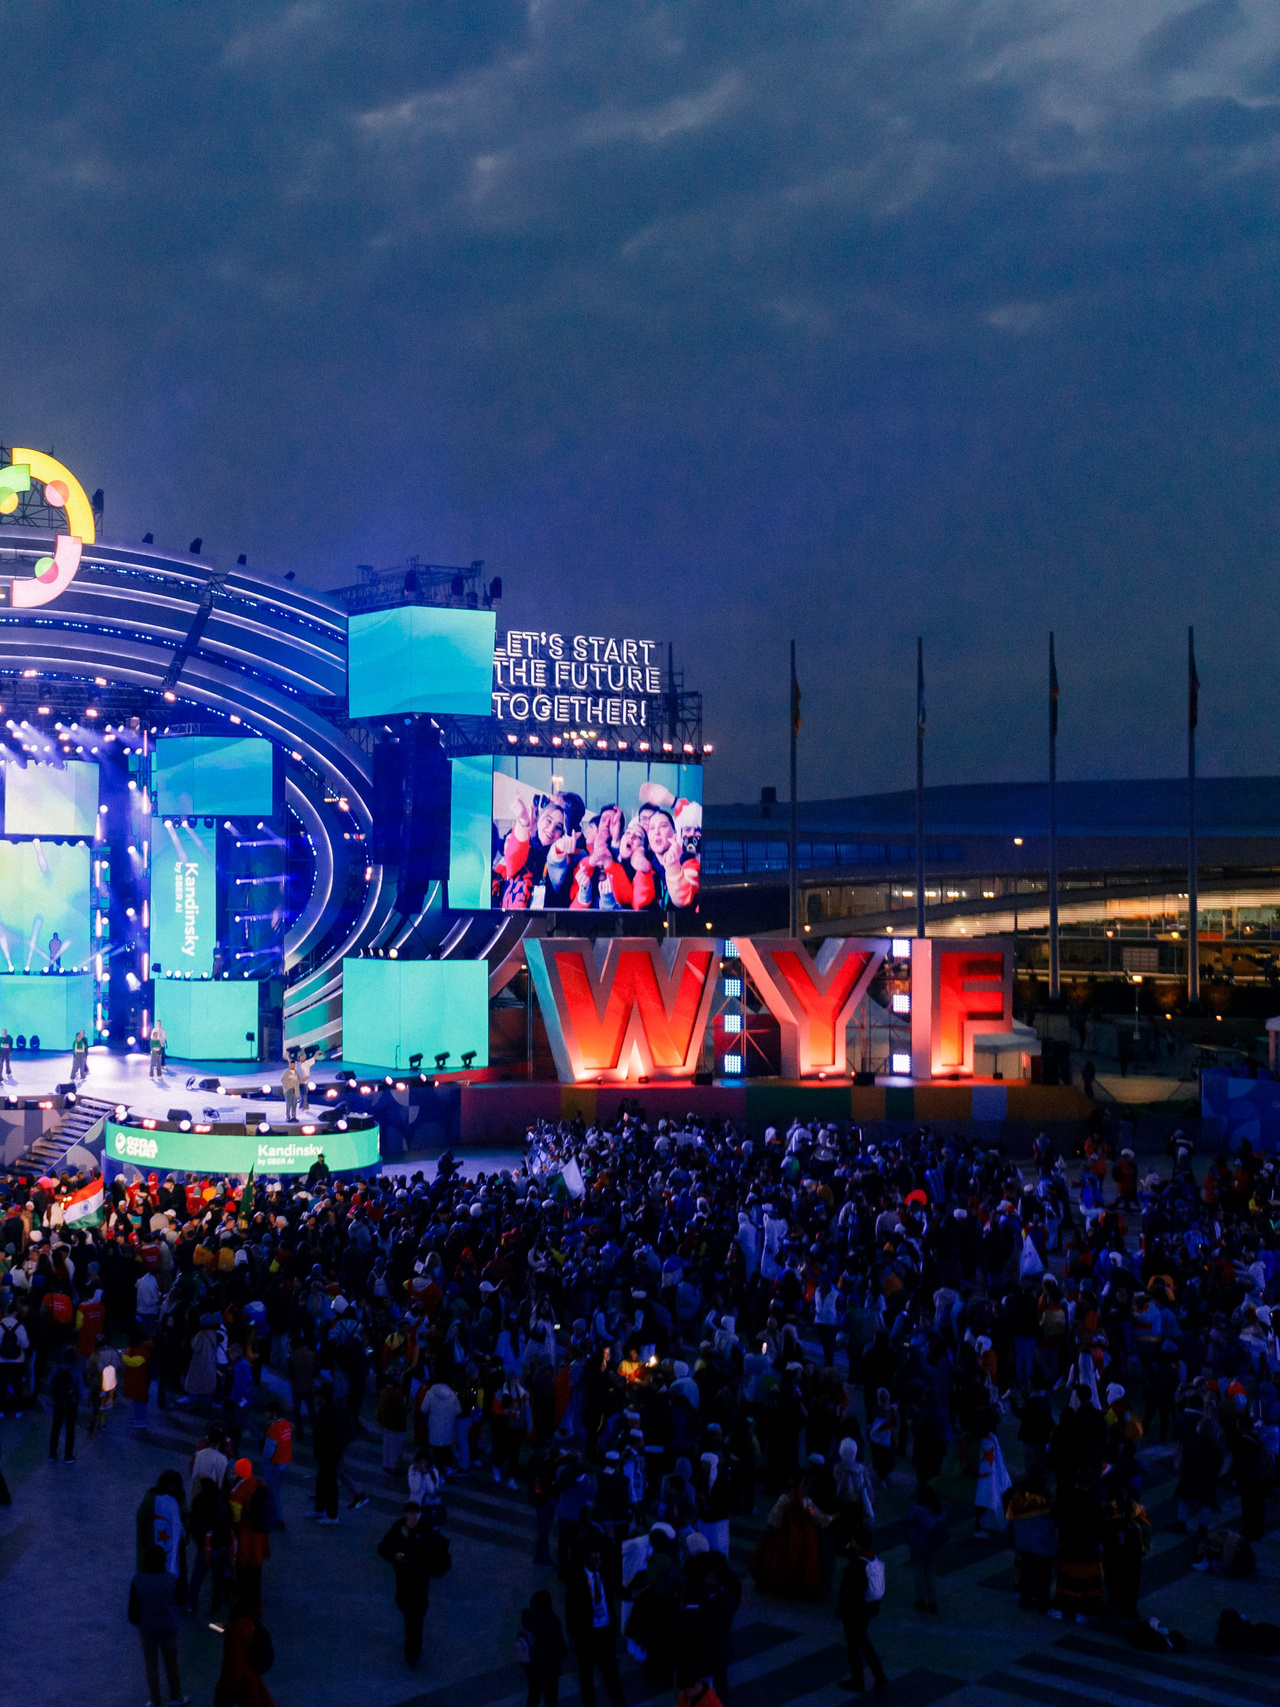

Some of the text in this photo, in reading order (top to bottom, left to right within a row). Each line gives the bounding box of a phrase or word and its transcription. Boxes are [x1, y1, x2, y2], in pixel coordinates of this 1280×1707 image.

[573, 635, 655, 665] START
[493, 657, 661, 693] THE FUTURE
[492, 692, 647, 726] TOGETHER!
[174, 862, 183, 873] by
[182, 863, 199, 957] Kandinsky
[526, 938, 1013, 1082] WYF
[258, 1143, 323, 1157] Kandinsky
